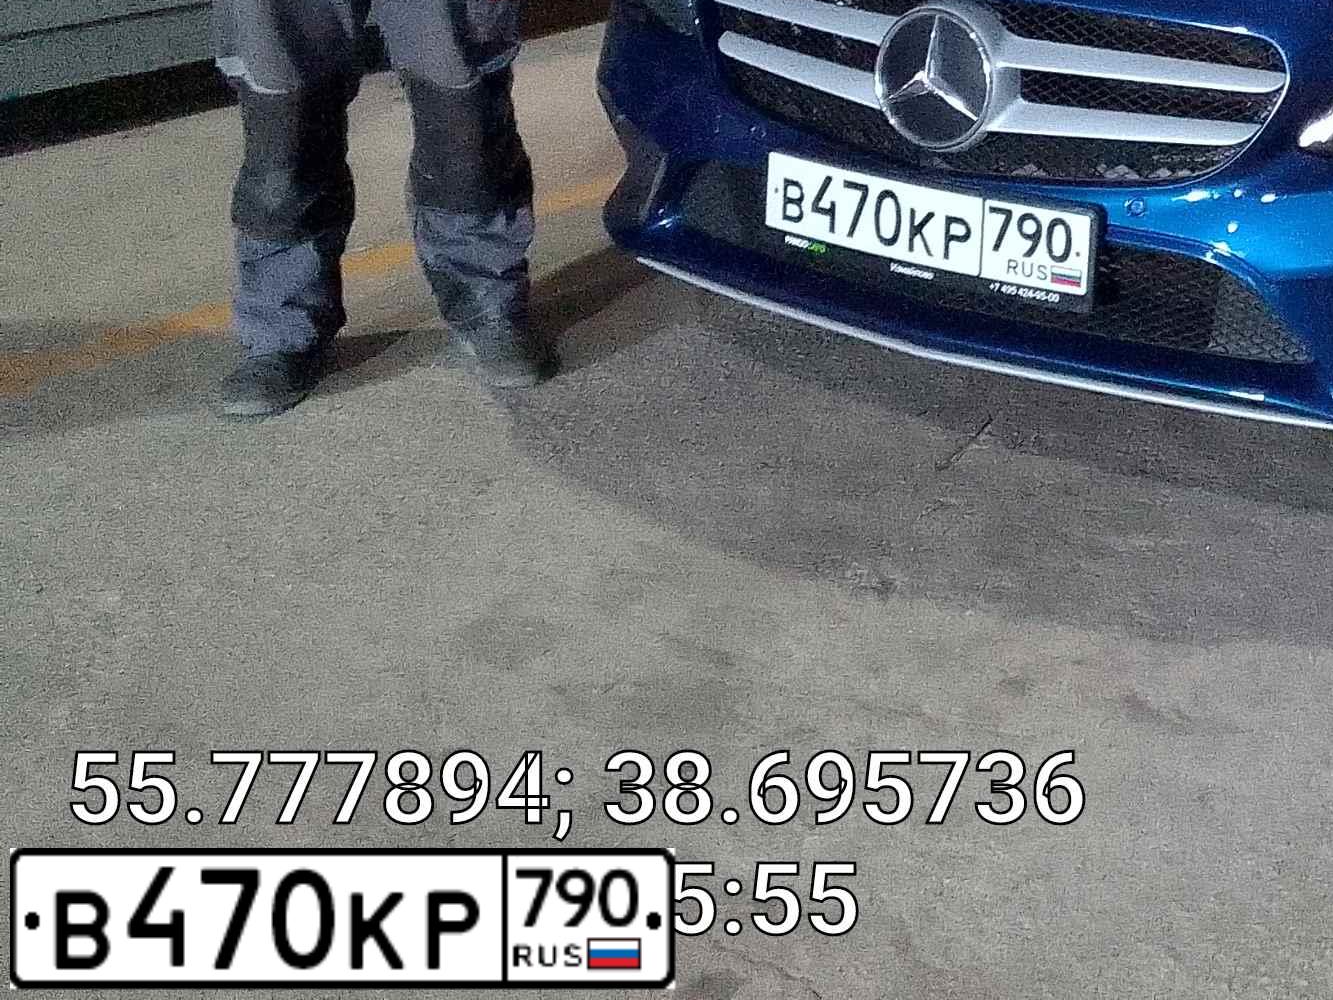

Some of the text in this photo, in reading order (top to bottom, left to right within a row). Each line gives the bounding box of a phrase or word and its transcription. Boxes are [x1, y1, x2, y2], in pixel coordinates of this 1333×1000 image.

[781, 175, 973, 260] В470КР
[988, 205, 1073, 263] 790
[1006, 258, 1049, 281] RUS
